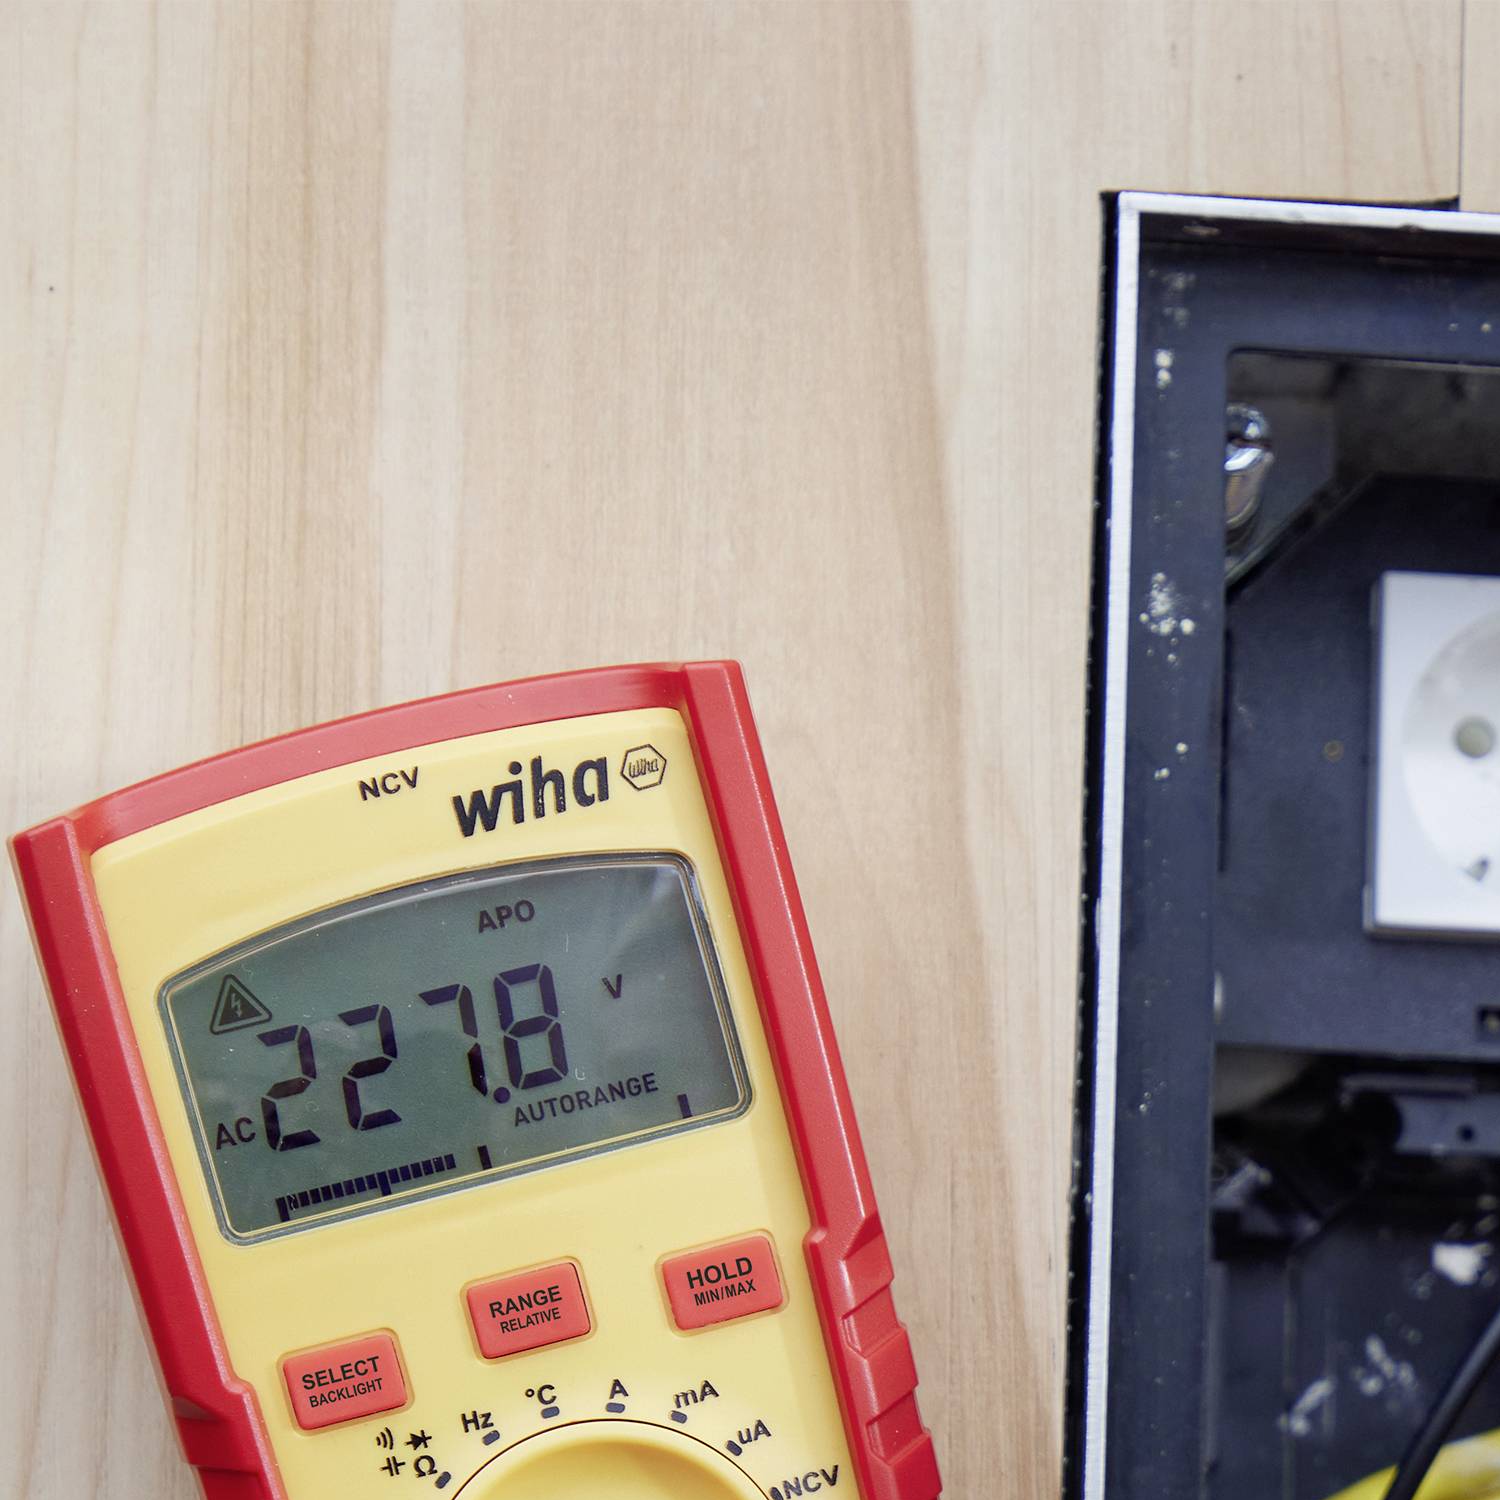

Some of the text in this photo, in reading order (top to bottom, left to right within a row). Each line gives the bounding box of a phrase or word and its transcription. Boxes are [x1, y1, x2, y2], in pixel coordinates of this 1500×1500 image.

[358, 767, 419, 801] NCV
[452, 755, 608, 838] wiha
[477, 900, 536, 934] APO
[601, 973, 625, 1000] V
[257, 963, 570, 1152] 227.8
[513, 1072, 659, 1127] AUTORANGE
[214, 1116, 257, 1151] AC
[687, 1257, 754, 1290] HOLD
[490, 1285, 563, 1319] RANGE
[694, 1280, 756, 1306] MIN/MAX
[500, 1307, 561, 1335] RELATIVE
[302, 1356, 381, 1391] SELECT
[608, 1379, 629, 1398] A
[309, 1377, 383, 1409] BACKLIGHT
[525, 1384, 557, 1405] °C
[674, 1380, 719, 1408] mA
[461, 1411, 494, 1433] Hz
[738, 1419, 771, 1447] uA
[783, 1465, 840, 1500] NCV
